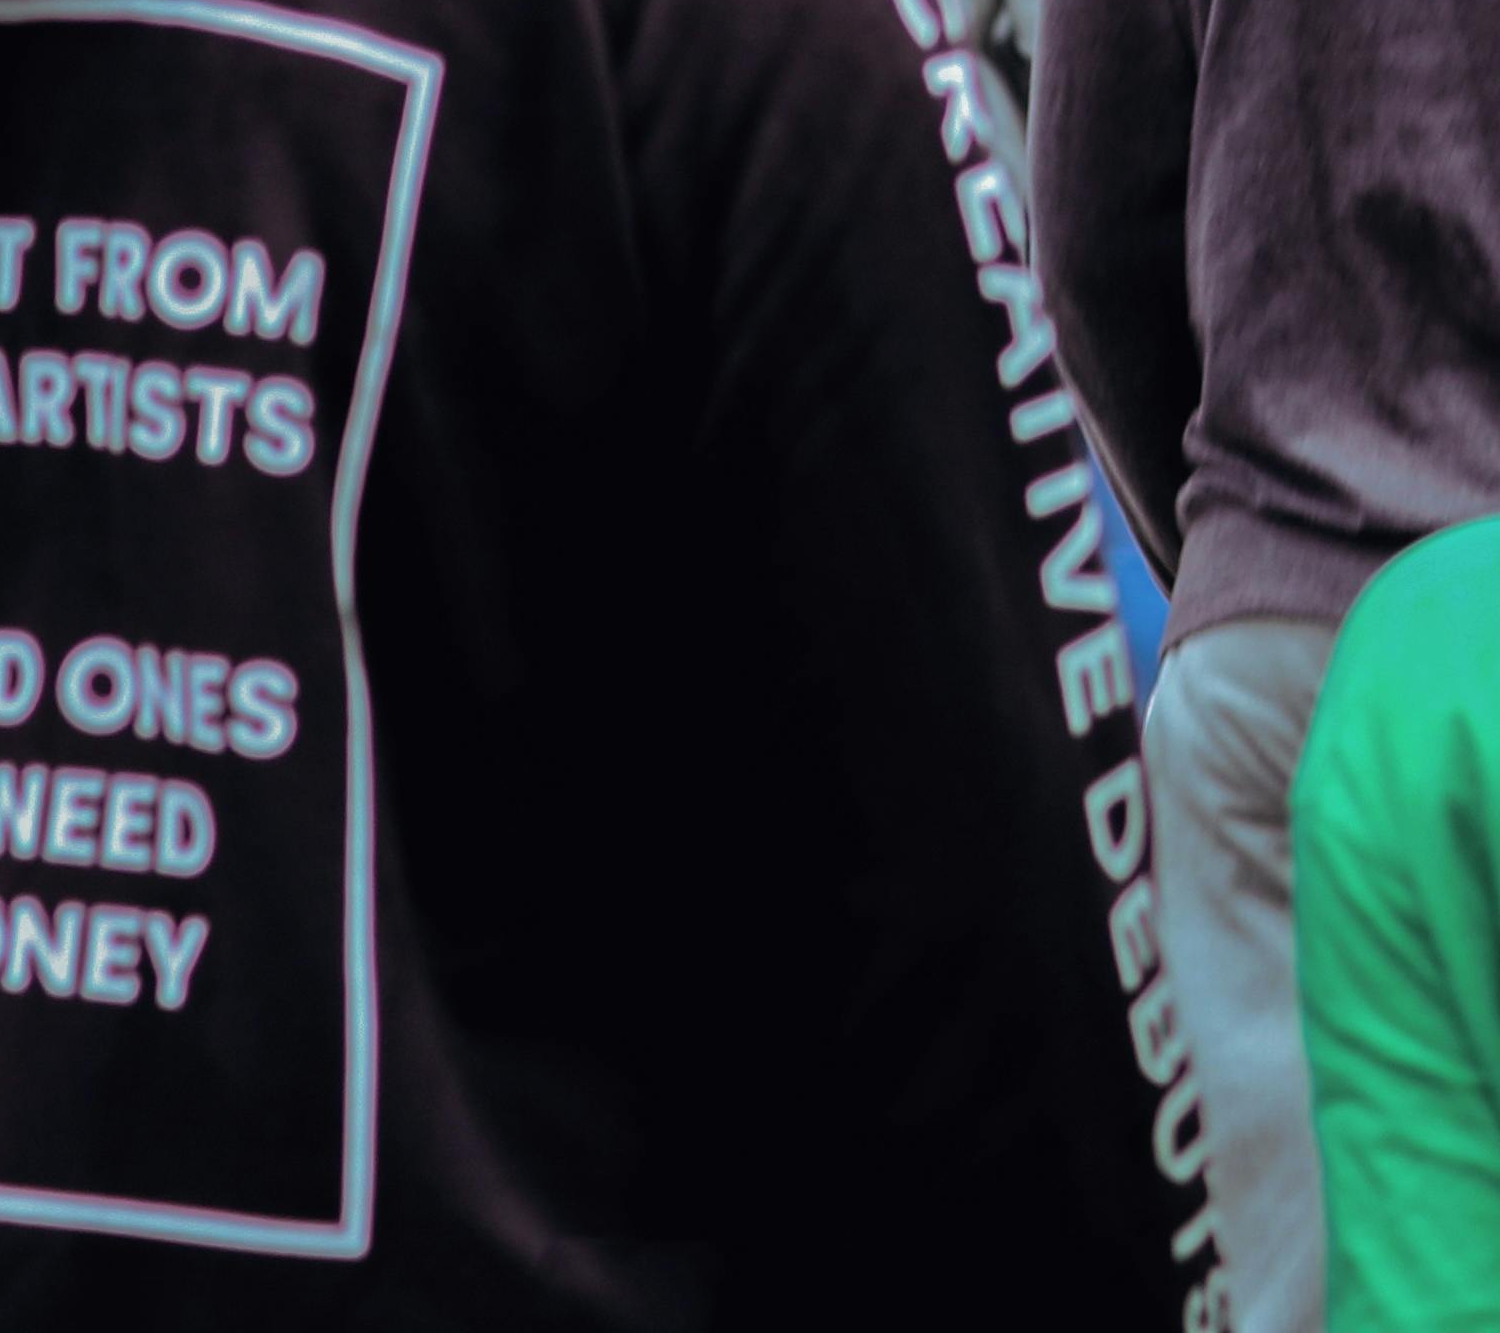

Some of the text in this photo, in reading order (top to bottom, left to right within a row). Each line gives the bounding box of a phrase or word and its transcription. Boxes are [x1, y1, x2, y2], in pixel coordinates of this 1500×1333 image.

[54, 217, 326, 346] FROM
[55, 635, 299, 760] ONES
[1083, 755, 1232, 1333] DEBUTS
